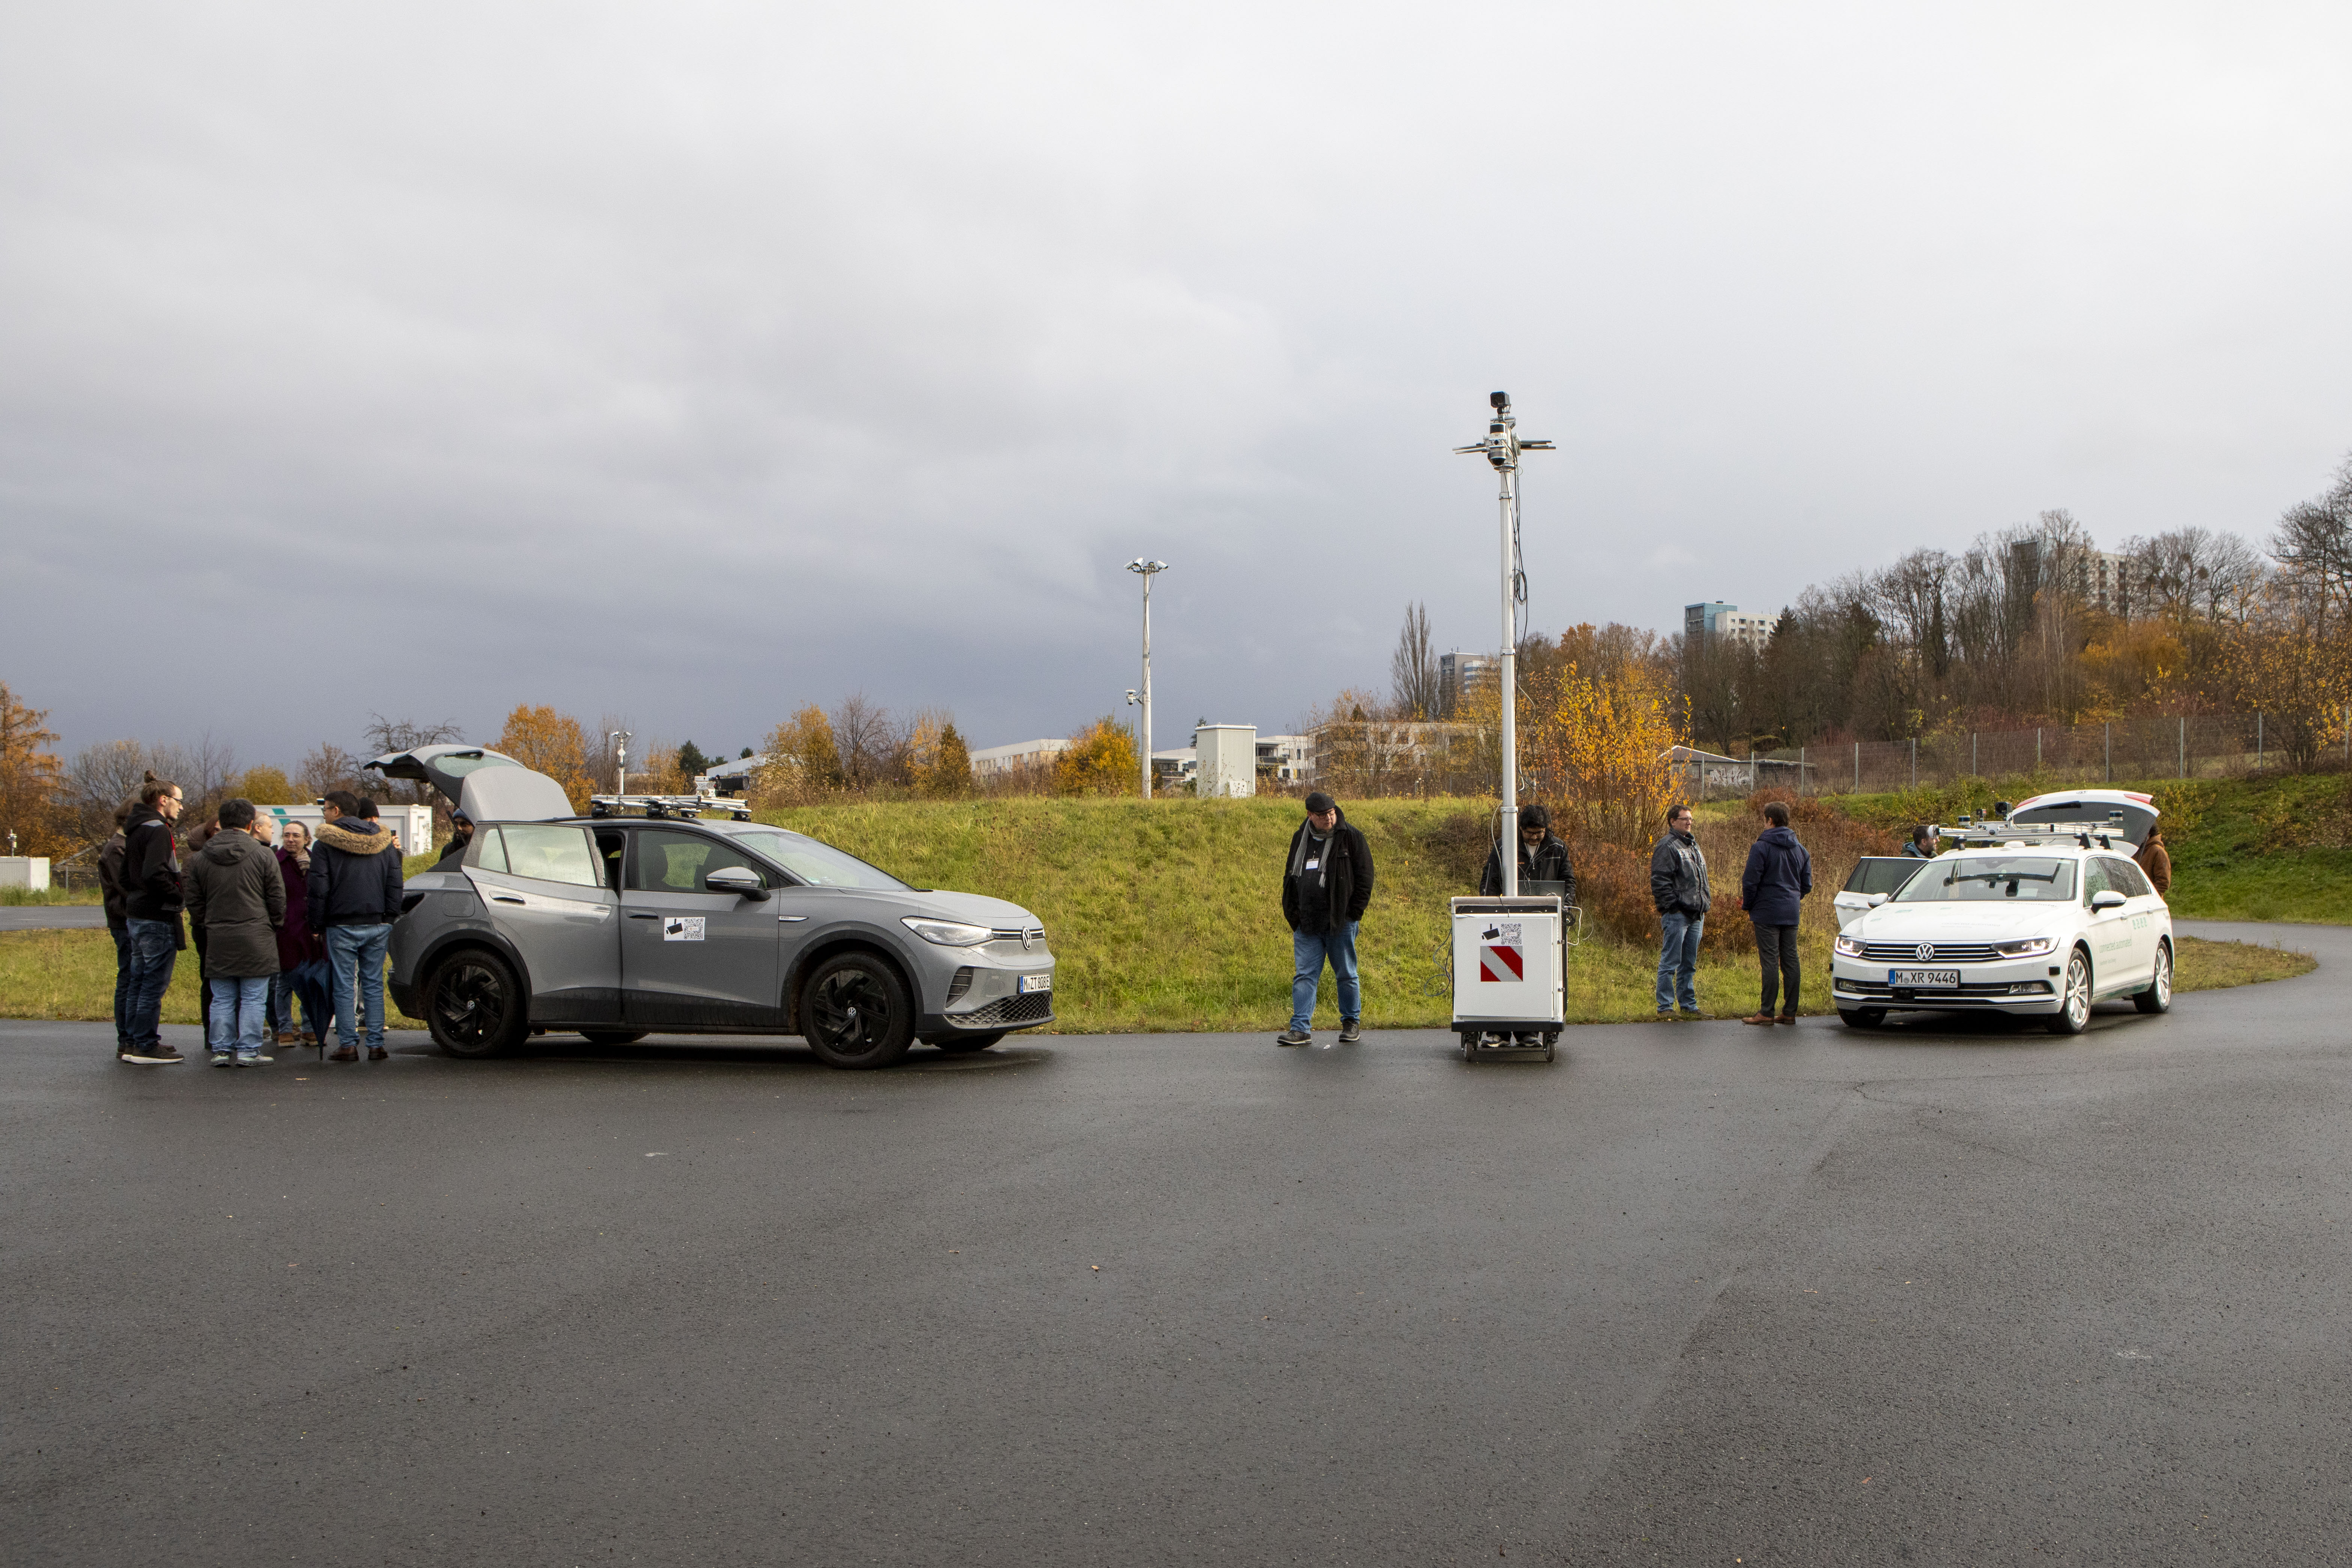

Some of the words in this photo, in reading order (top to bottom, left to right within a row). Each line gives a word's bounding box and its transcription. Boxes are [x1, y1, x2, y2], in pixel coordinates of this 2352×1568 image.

[1916, 943, 1934, 961] VW
[1024, 978, 1028, 990] M
[1031, 977, 1037, 990] ZT
[1896, 972, 1903, 983] M
[1911, 972, 1924, 983] XR
[1928, 972, 1956, 983] 9446
